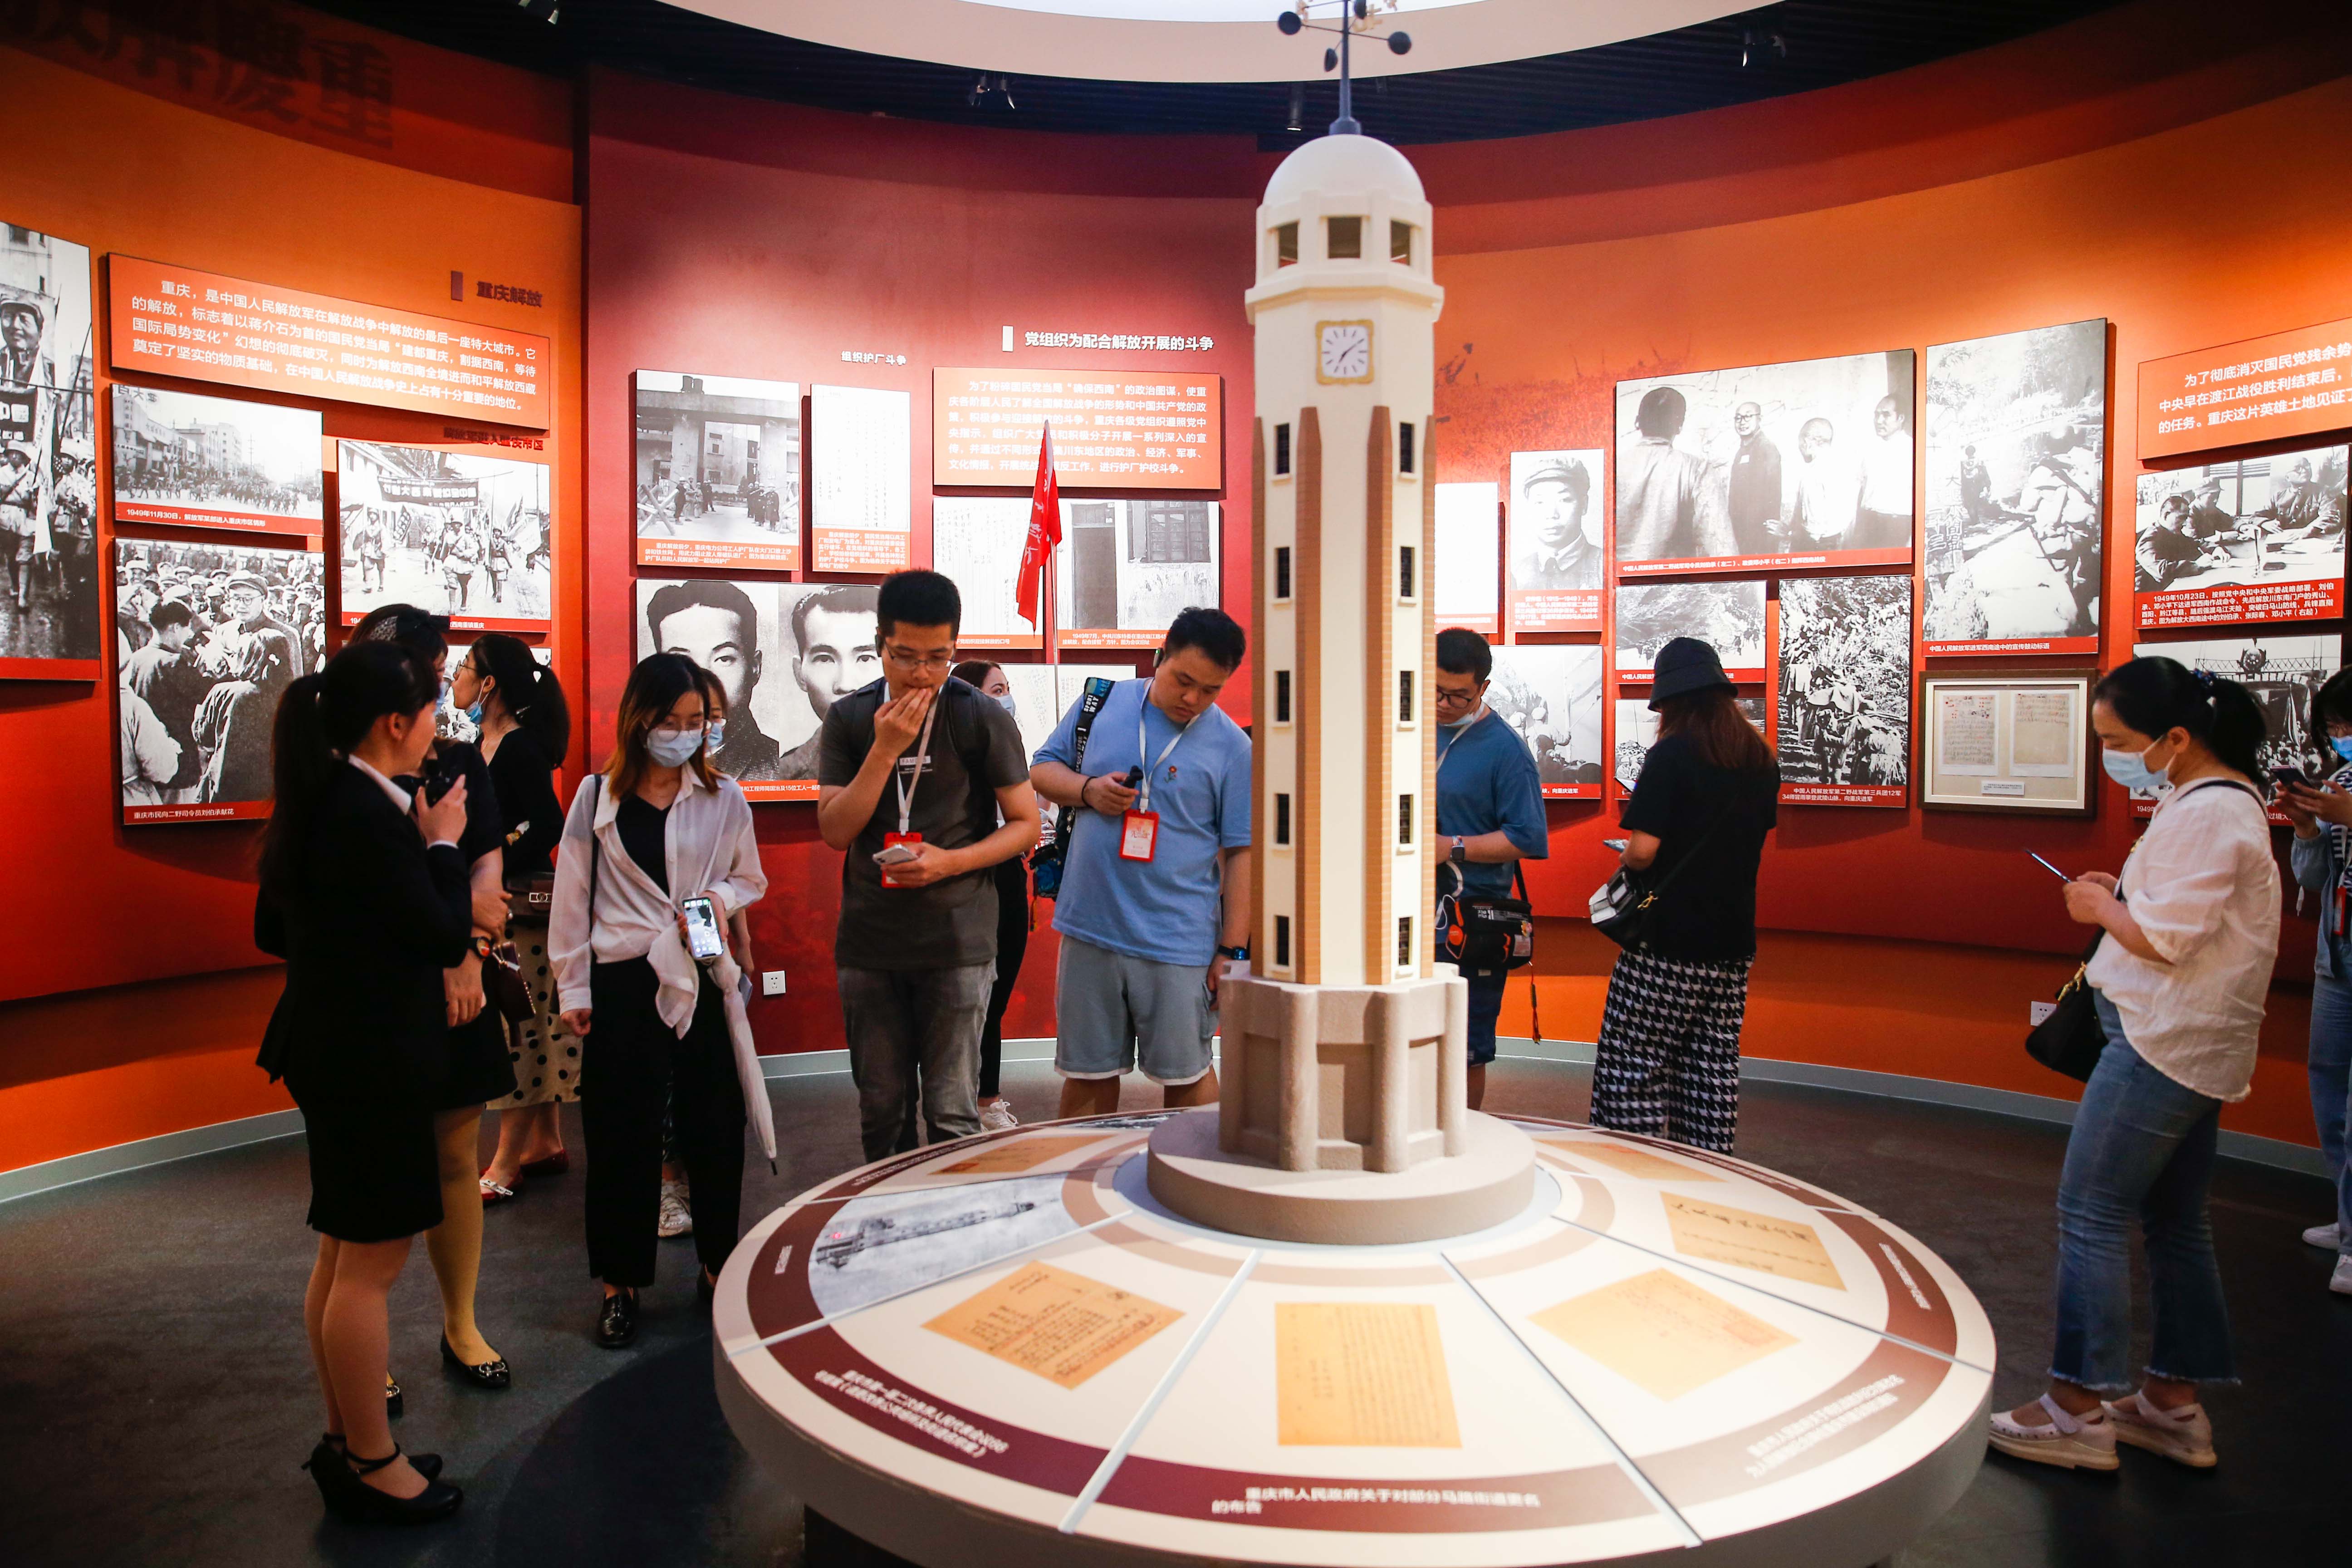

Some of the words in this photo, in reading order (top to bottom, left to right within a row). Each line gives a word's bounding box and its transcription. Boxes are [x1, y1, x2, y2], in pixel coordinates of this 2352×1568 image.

[476, 280, 543, 308] 重庆解放
[161, 280, 536, 360] 重庆，是中国人民解放军在解放战争中解放的最后一座特大城市。它
[132, 296, 536, 377] 的解放，标志着以蒋介石为首的国民党当局“建都重庆，割据西南，等待
[1024, 331, 1214, 351] 党组织为配合解放开展的斗争
[132, 317, 537, 396] 国际局势变化”幻想的彻底破灭，同时为解放西南全境进而和平解放西藏
[841, 350, 907, 366] 组织护厂斗争
[2185, 341, 2352, 388] 为了彻底消灭国民党残余势
[132, 338, 523, 410] 奠定了坚实的物质基础，在中国人民解放战争史上占有十分重要的地位。
[969, 380, 1207, 397] 为了粉碎国民党当局“确保西南”的政治图谋，使重
[2159, 368, 2352, 413] 中央早在渡江战役胜利结束后，
[948, 396, 1207, 413] 庆各阶层人民了解全国解放战争的形势和中国共产党的政
[948, 443, 1203, 460] 传，并通过不同形式集川东地区的政治、经济、军事、
[948, 458, 1185, 475] 文化情报，开展统战策反工作，进行护厂护校斗争。
[126, 509, 266, 527] 1949年11月30日，解放军某部进入重庆市区情形
[2141, 592, 2331, 611] 承、邓小平下达进军西南作战命令，先后解放川东南门户的秀山、
[2154, 583, 2334, 602] 1949年10月23日，按照党中央和中央军委战略部署，刘伯
[450, 621, 485, 630] 西南重镇重庆
[1929, 642, 2050, 652] 中国人民解放军进军西南途中的宣传鼓动标语
[133, 808, 235, 820] 重庆市民向二野司令员刘伯承献花
[1211, 1499, 1262, 1515] 的布告
